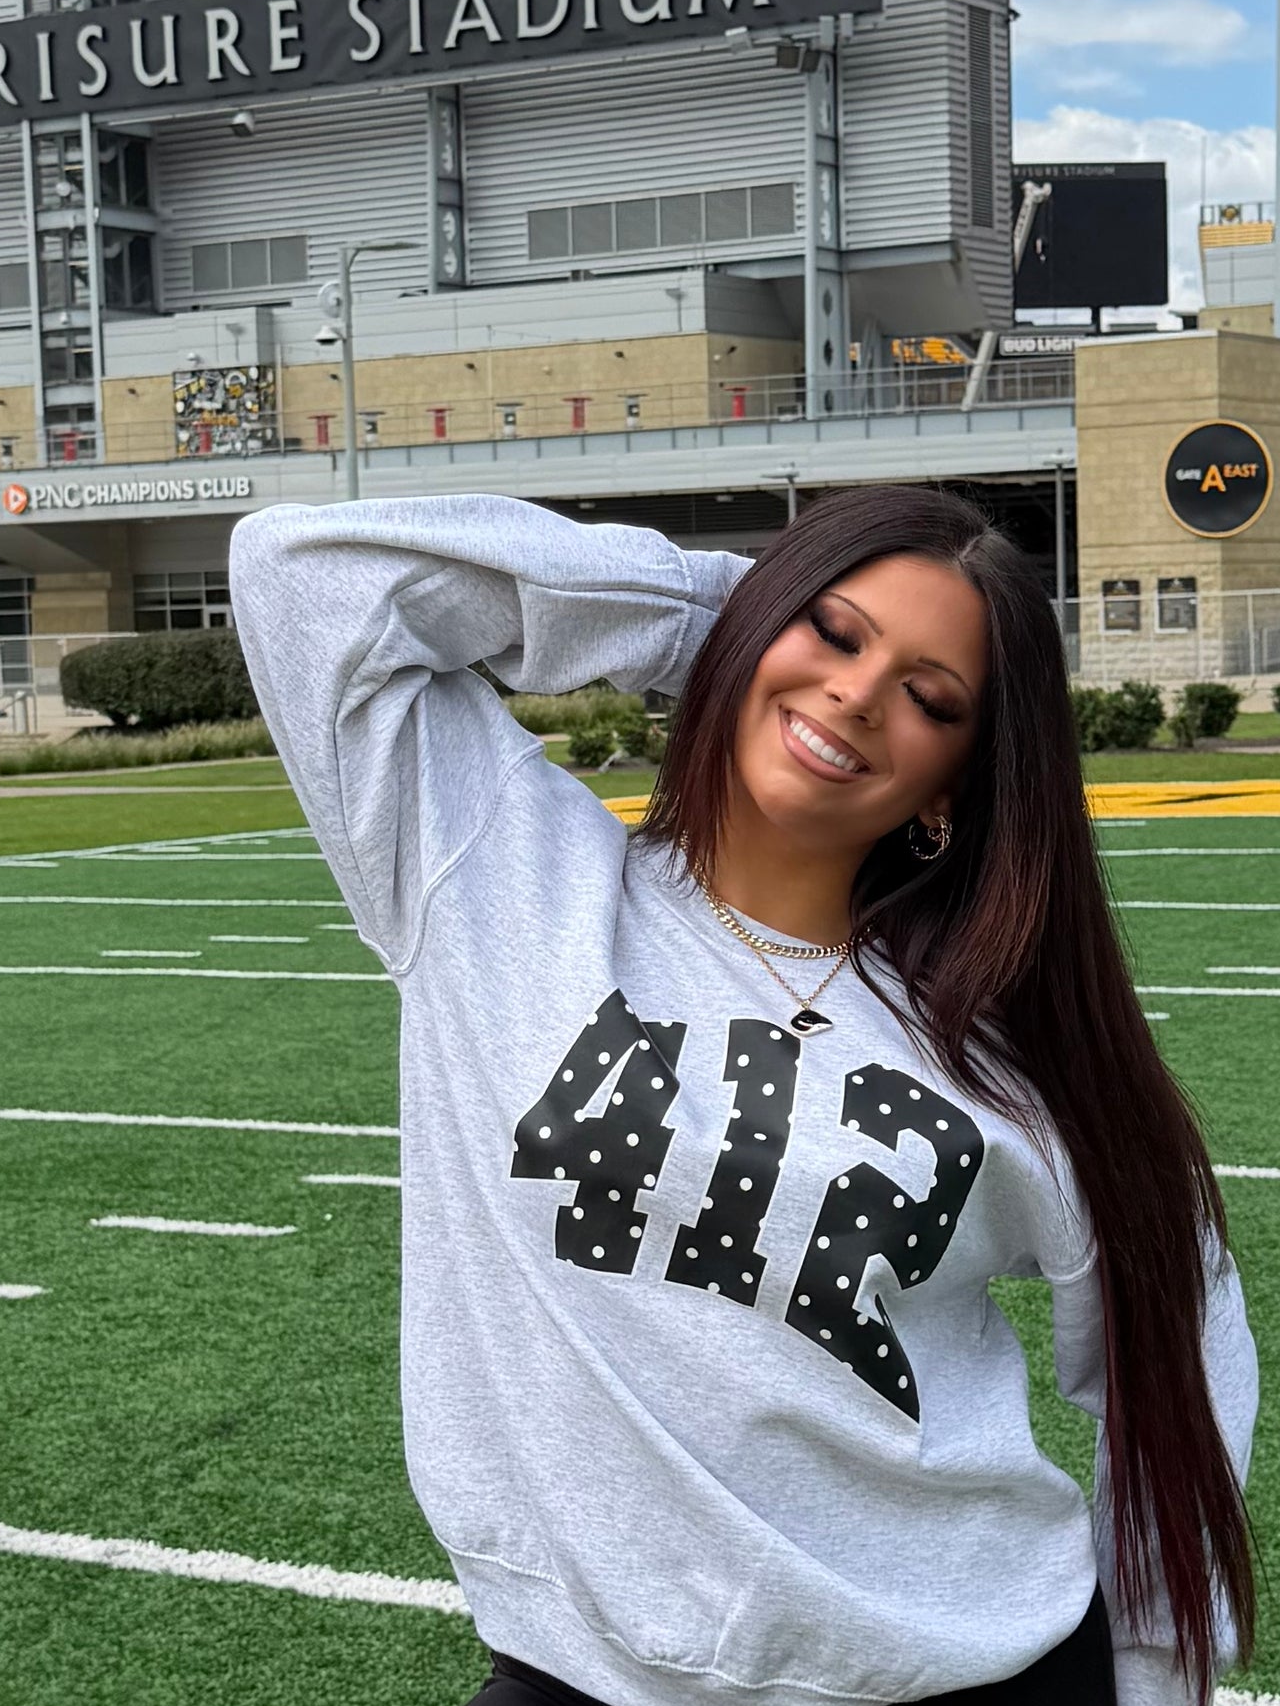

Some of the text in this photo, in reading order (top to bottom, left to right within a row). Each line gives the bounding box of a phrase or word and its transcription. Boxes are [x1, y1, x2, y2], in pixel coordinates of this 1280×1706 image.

[1012, 165, 1116, 177] RISURE STADIUM
[1004, 337, 1073, 353] BUD LIGH
[31, 476, 251, 510] PNC CHAMPIONS CLUB
[1200, 463, 1227, 493] A
[1223, 463, 1260, 478] EAST
[509, 986, 985, 1424] 412
